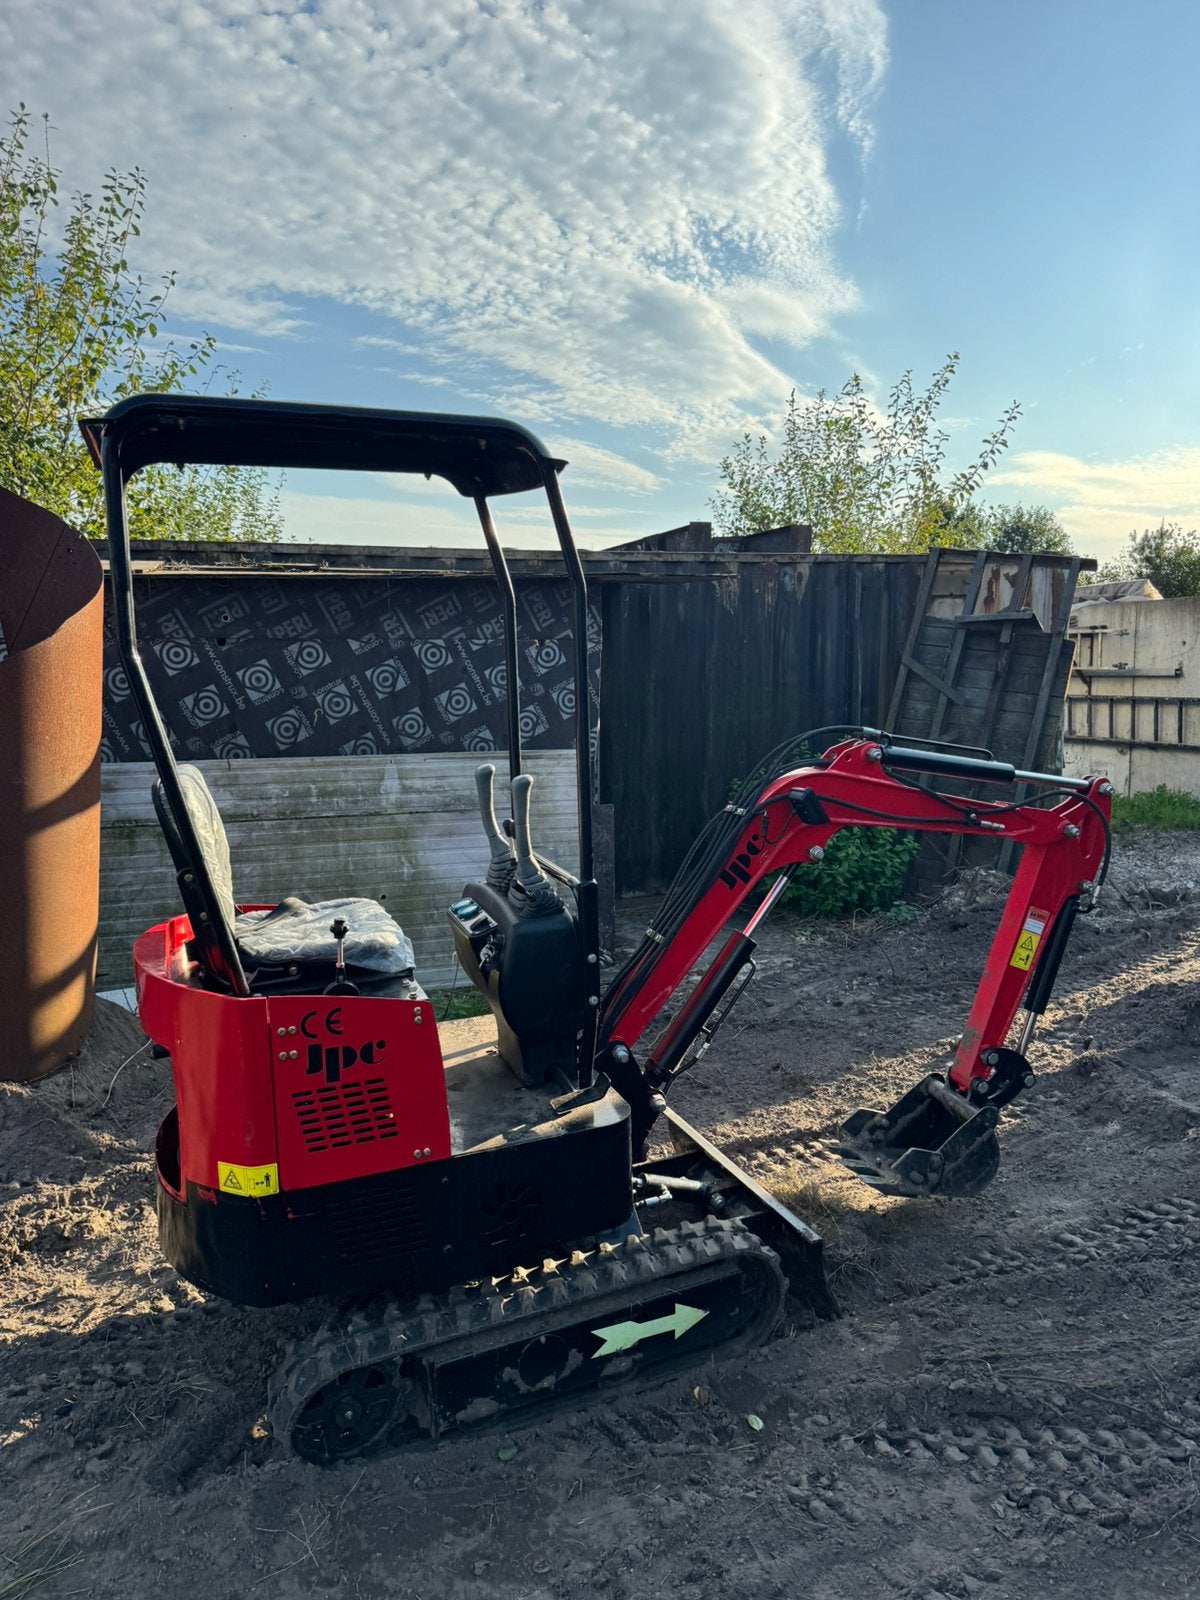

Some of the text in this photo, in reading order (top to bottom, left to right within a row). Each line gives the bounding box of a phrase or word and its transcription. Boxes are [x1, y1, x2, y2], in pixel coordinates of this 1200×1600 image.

[418, 599, 458, 631] PERI
[528, 589, 556, 629] PERI
[271, 611, 313, 639] PERI
[300, 1008, 344, 1039] CE
